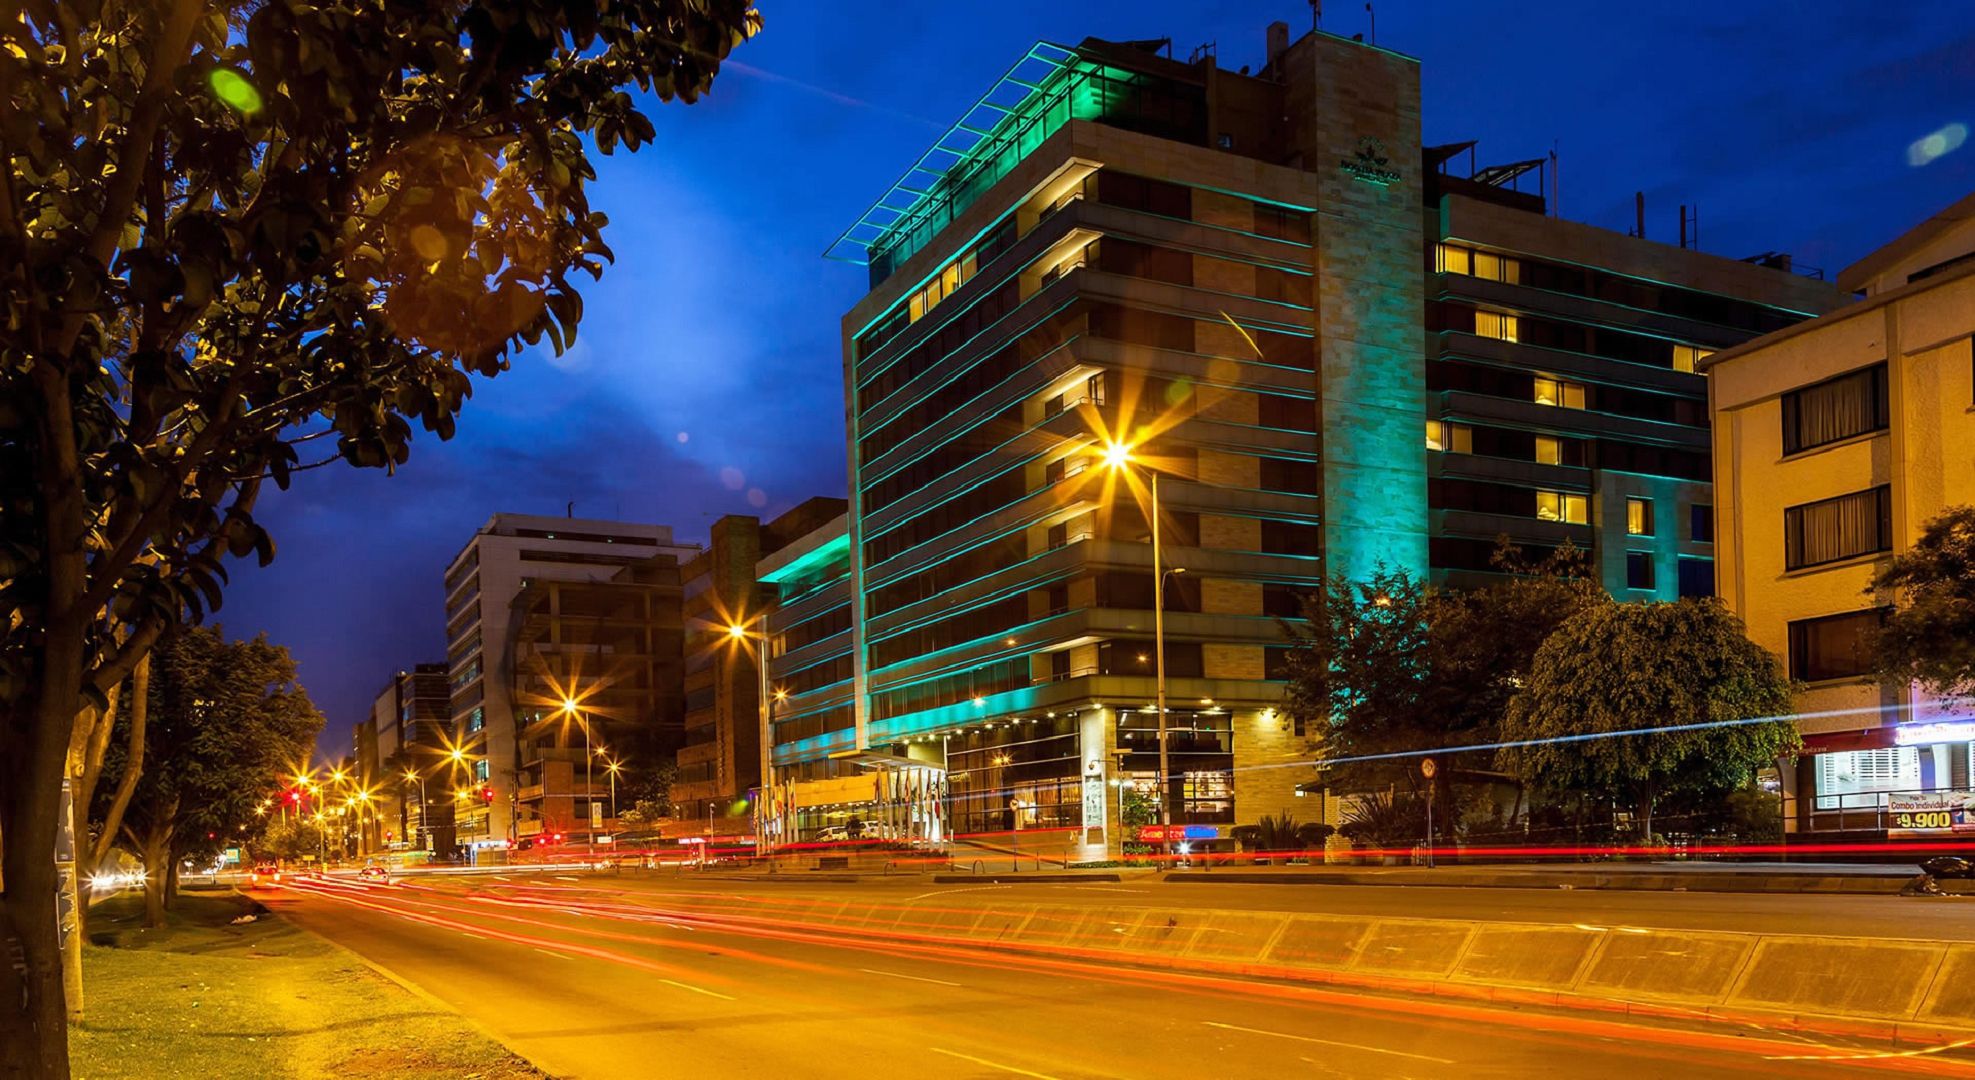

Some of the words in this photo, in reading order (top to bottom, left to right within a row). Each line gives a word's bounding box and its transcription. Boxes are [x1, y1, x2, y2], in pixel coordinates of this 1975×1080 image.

[1891, 801, 1914, 810] Combo
[1915, 800, 1949, 809] Individual
[1896, 811, 1951, 828] $9.900
